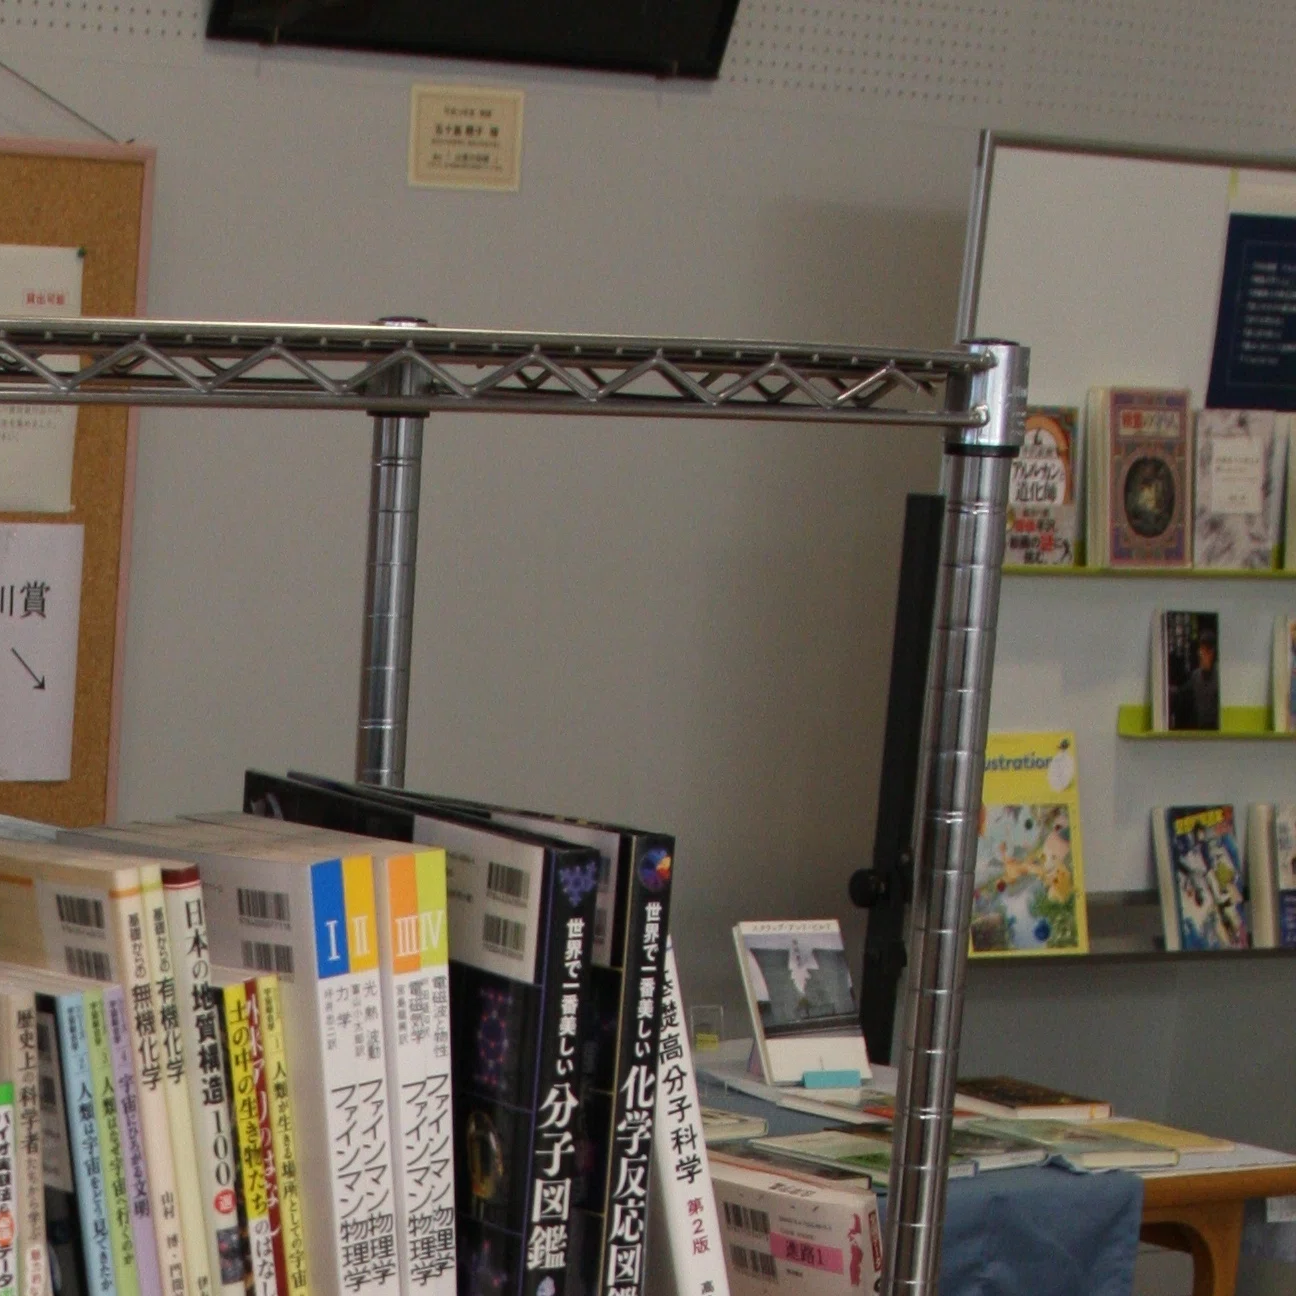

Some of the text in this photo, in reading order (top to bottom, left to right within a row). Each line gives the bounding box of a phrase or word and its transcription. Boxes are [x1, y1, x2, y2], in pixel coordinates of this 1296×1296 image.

[128, 913, 162, 1091] 基礎からの無機化学
[153, 907, 186, 1084] 基礎からの有機化学
[325, 919, 341, 961] I
[336, 985, 353, 1030] 力学
[363, 979, 377, 998] 光
[432, 975, 449, 1058] 電磁波と物性
[103, 1076, 133, 1266] 人類はなぜ宇宙へ行くのか
[117, 1074, 150, 1217] 宇宙にひろがる文明
[273, 1060, 306, 1288] 人類が生きる場所としての宇宙
[358, 1078, 397, 1286] ファインマン物理学
[401, 1080, 436, 1287] ファインマン物理学
[426, 1073, 455, 1277] ファインマン物理学
[526, 917, 585, 1270] 世界で一番美しい分子図鑑
[79, 1082, 114, 1292] 人類は宇宙をどう見てきたか
[331, 1083, 373, 1294] ファインマン物理学
[687, 1197, 711, 1256] 第2版
